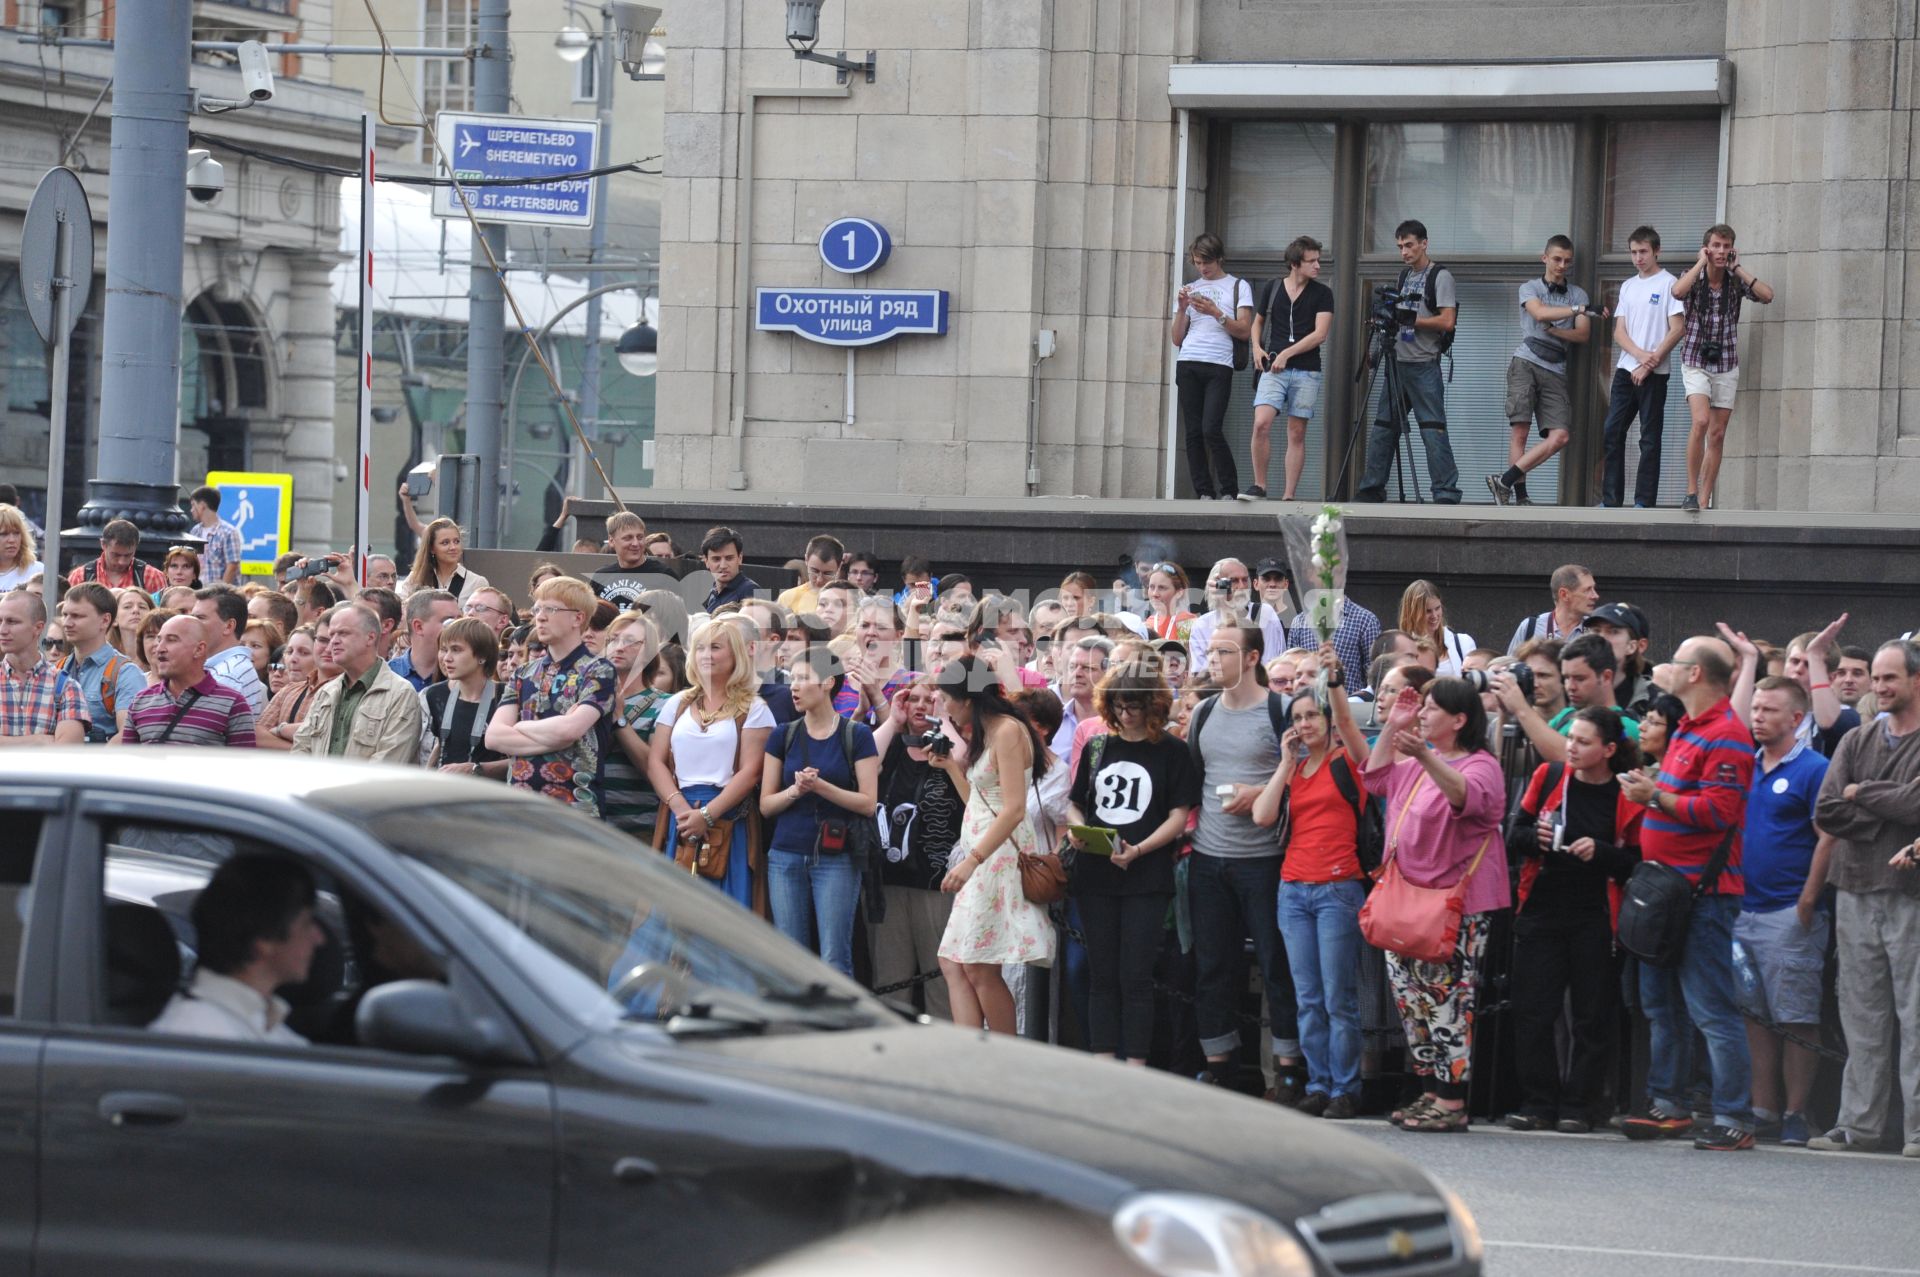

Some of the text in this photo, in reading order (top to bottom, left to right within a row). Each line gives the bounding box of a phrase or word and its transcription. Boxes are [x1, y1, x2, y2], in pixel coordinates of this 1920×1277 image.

[487, 129, 576, 148] ШЕРЕМЕТЬЕВО
[486, 149, 577, 167] SHEREMETYEVO
[482, 194, 579, 212] ST.-PETERSBURG
[842, 230, 855, 261] 1
[775, 294, 919, 320] Охотный ряд
[820, 318, 872, 335] улица
[600, 579, 629, 598] RMANI
[1101, 774, 1141, 812] 31
